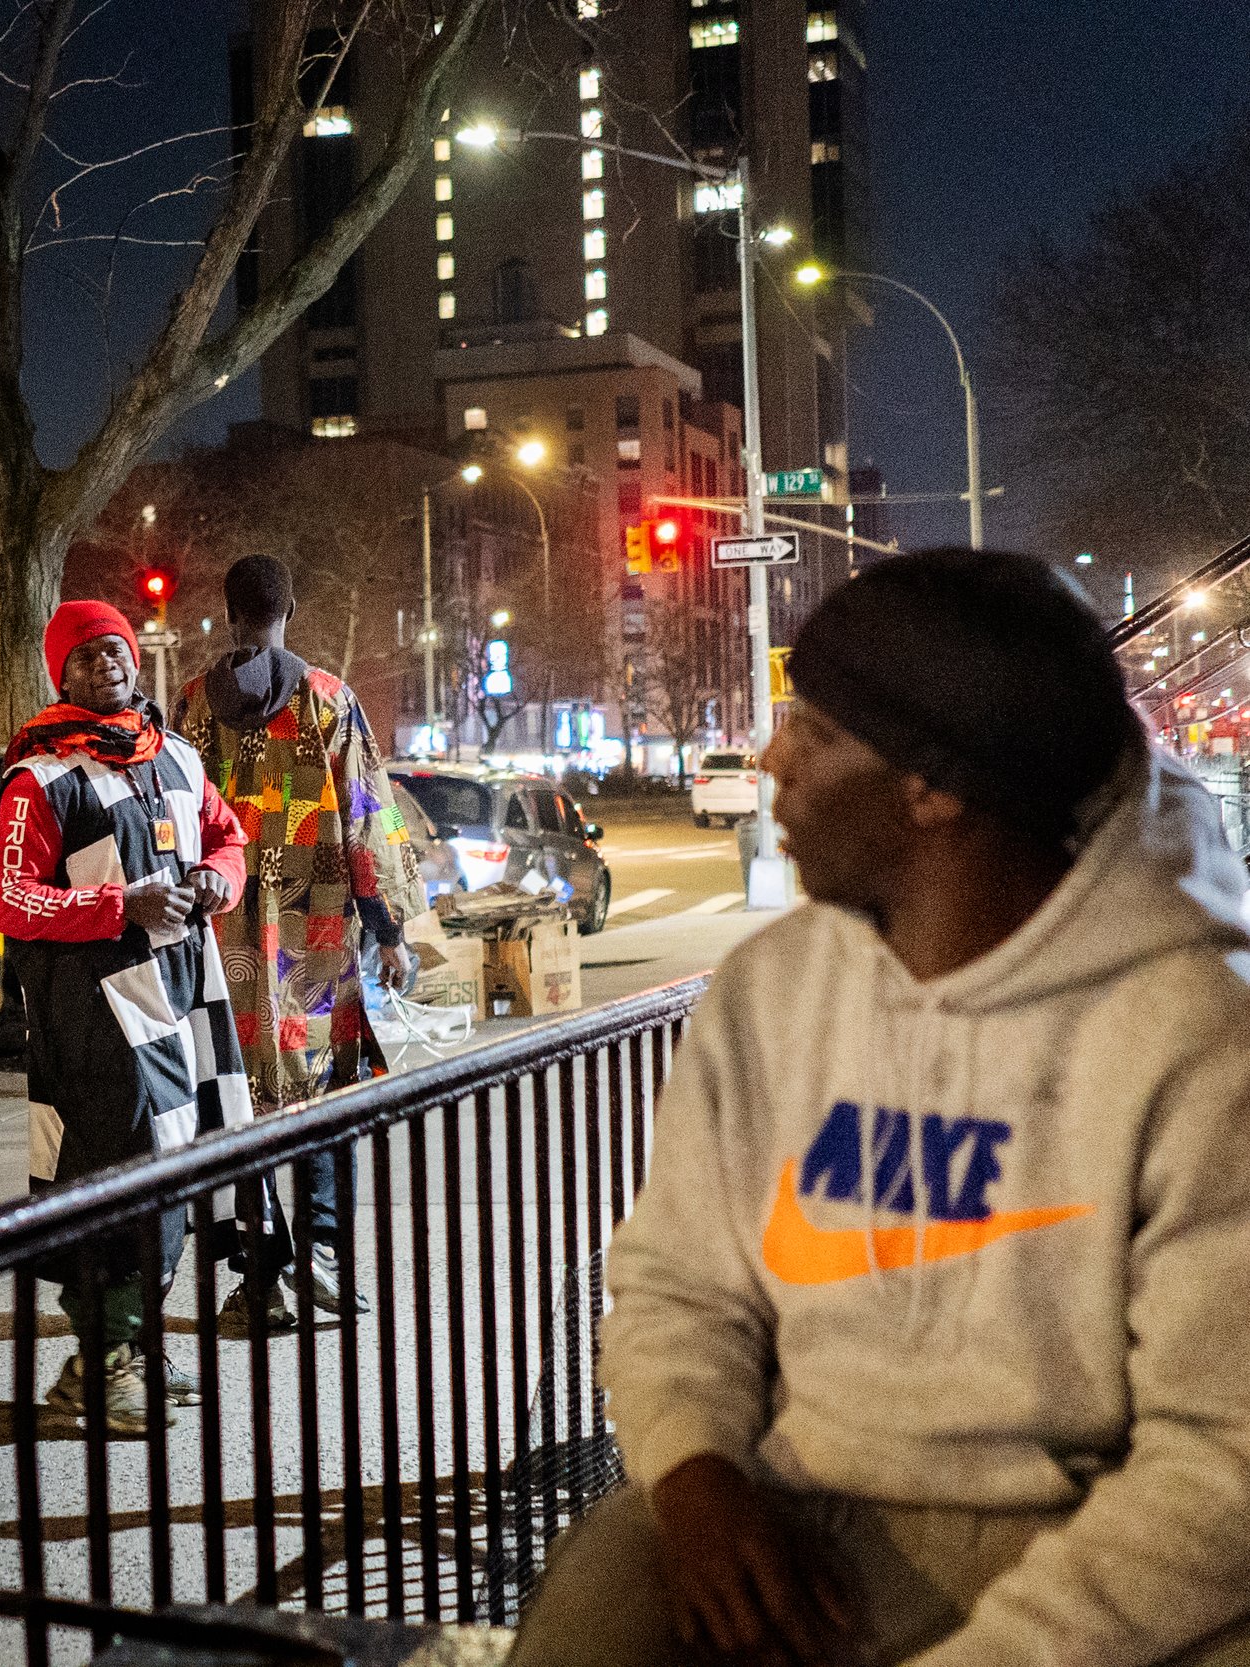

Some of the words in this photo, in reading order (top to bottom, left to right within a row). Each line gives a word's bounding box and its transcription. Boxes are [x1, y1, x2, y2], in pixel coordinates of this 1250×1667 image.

[769, 476, 778, 493] W
[784, 474, 805, 491] 129
[725, 546, 748, 558] ONE
[760, 543, 784, 556] WAY
[800, 1100, 1012, 1222] NIKE
